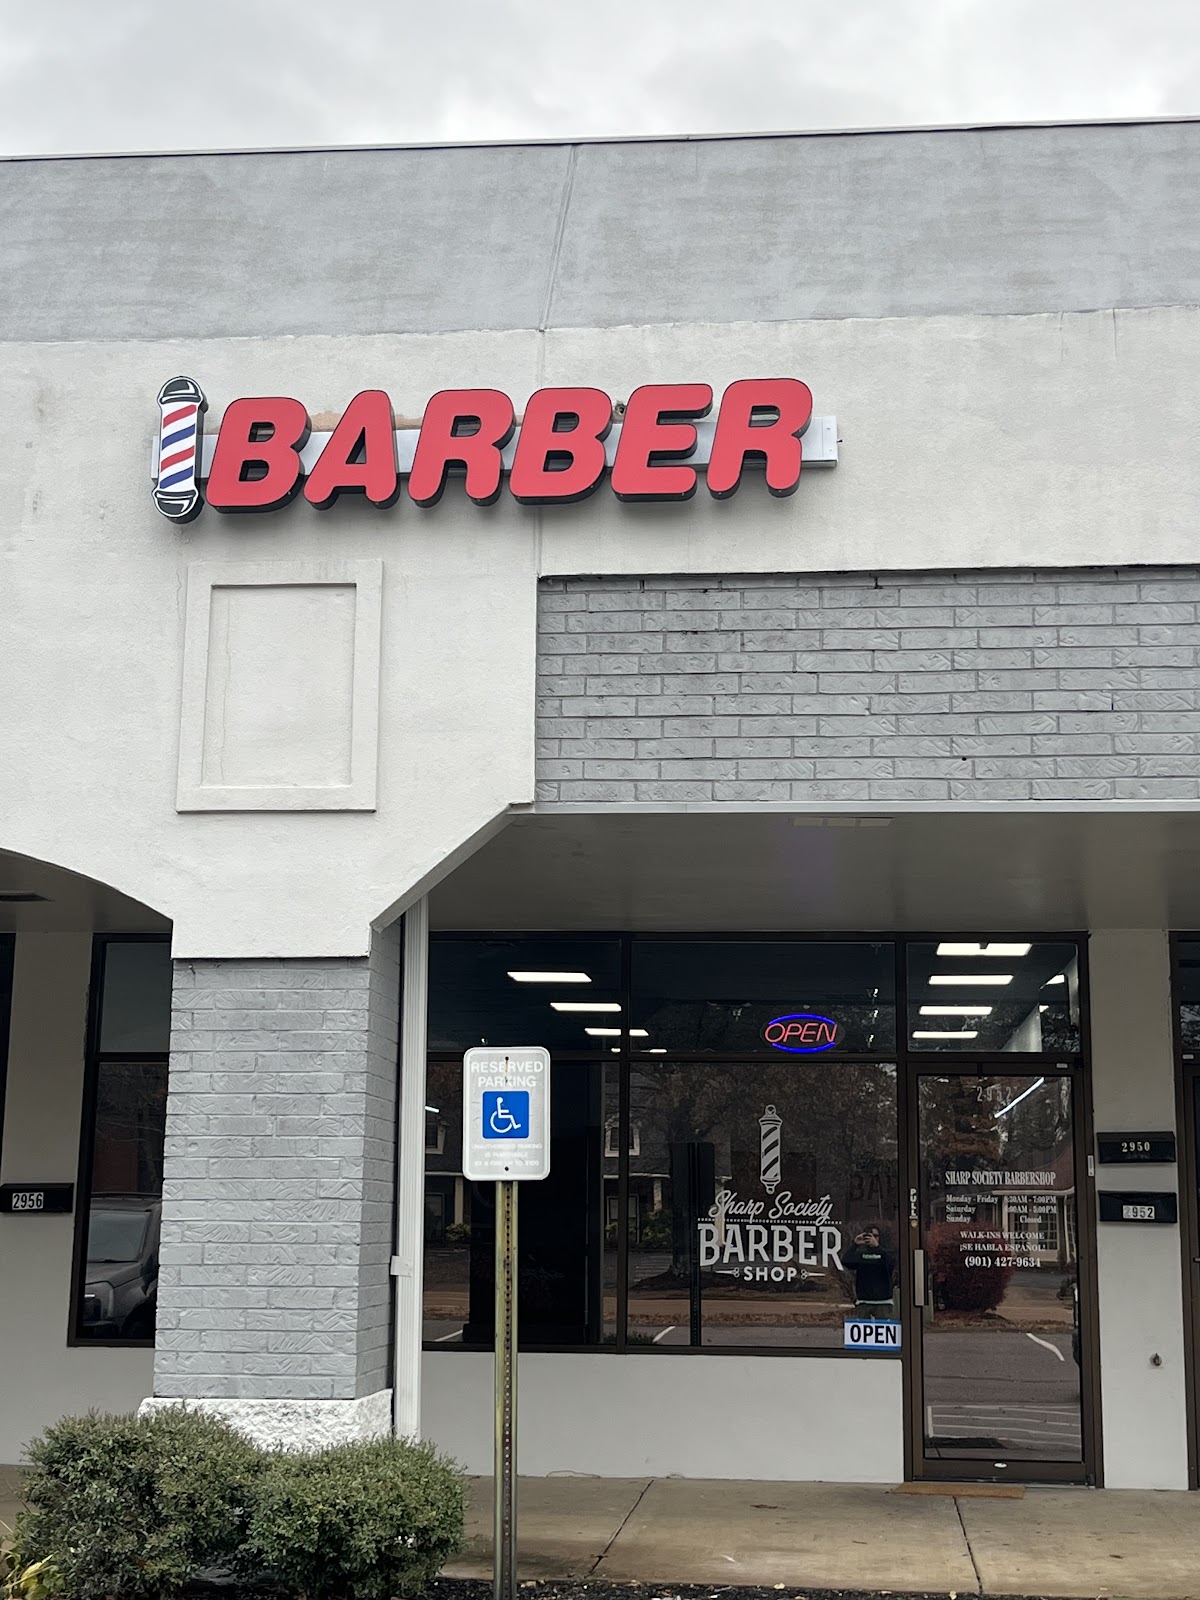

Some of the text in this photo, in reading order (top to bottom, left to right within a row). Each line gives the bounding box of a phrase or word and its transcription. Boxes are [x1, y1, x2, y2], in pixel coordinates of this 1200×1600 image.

[205, 377, 813, 508] BARBER
[764, 1022, 838, 1043] OPEN
[470, 1061, 544, 1074] RESERVED
[477, 1075, 537, 1088] PARKING
[976, 1086, 1012, 1102] 2952
[1121, 1141, 1150, 1152] 2950
[945, 1171, 1056, 1186] SHARP SOCIETY BARBERSHOP
[13, 1193, 43, 1209] 2956
[946, 1194, 972, 1204] Monday
[976, 1194, 999, 1204] Friday
[708, 1190, 834, 1226] Sharp Society
[946, 1204, 976, 1214] Saturday
[1123, 1206, 1154, 1219] 2952
[946, 1214, 1042, 1224] Sunday Closed
[960, 1231, 1045, 1239] WALK-INS WELCOME
[697, 1223, 844, 1272] BARBER
[974, 1243, 1003, 1252] HABLA
[964, 1255, 1041, 1268] (901) 427-9634
[743, 1266, 798, 1282] SHOP
[850, 1324, 897, 1344] OPEN
